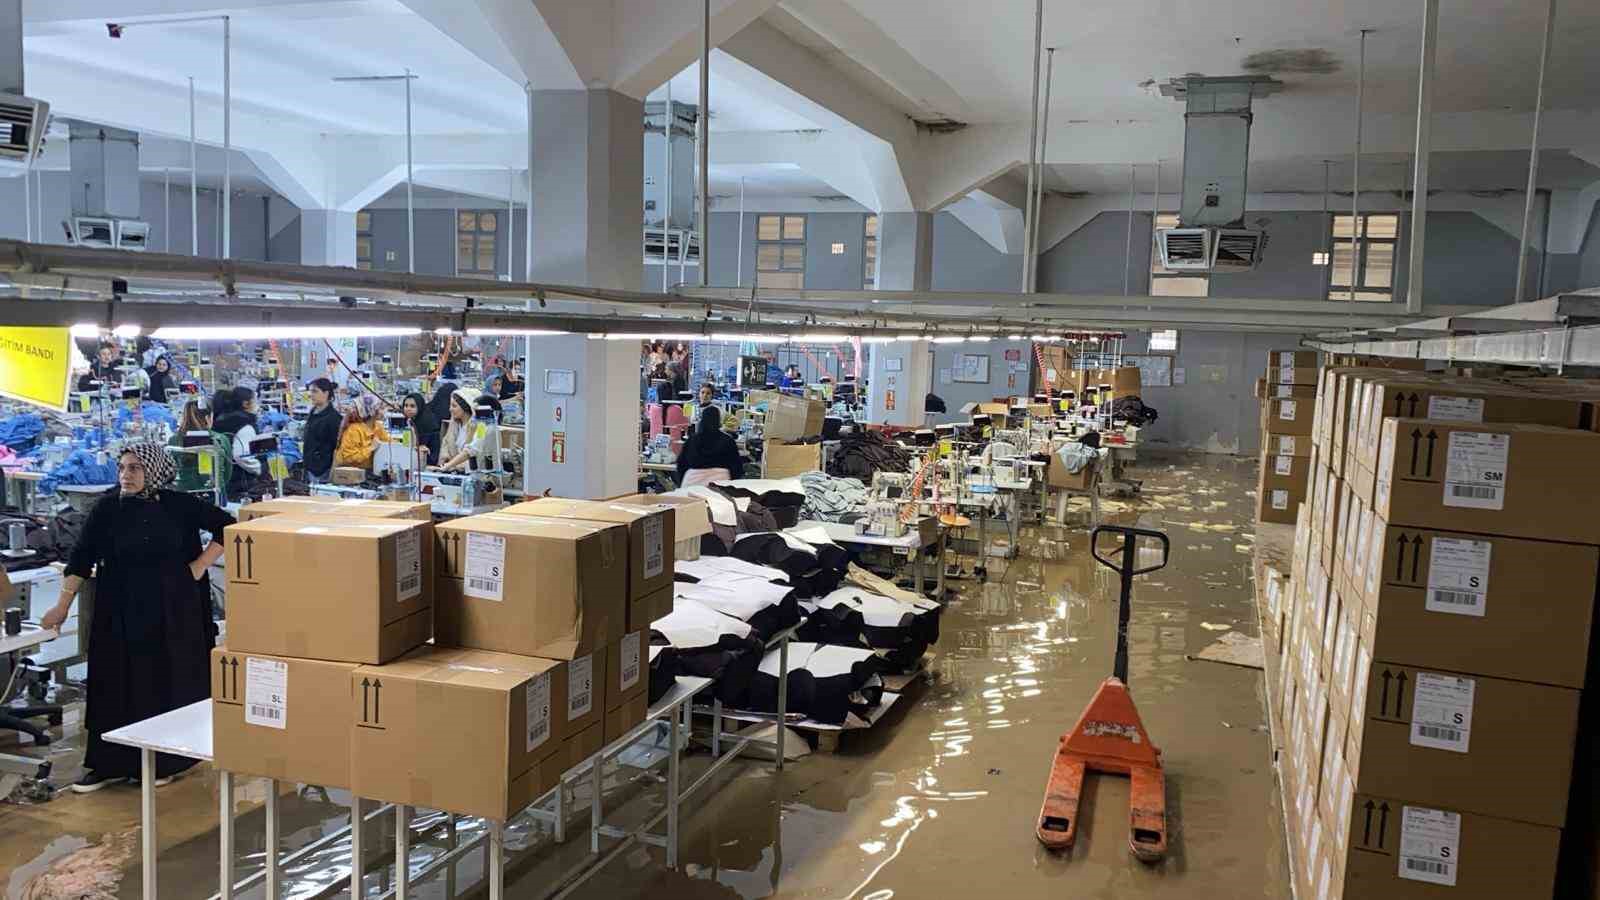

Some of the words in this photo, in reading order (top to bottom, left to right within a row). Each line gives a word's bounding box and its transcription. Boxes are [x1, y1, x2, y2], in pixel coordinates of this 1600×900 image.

[26, 344, 54, 361] BANDI
[556, 406, 562, 422] 9
[1484, 471, 1504, 481] SM
[492, 566, 499, 577] S
[1469, 576, 1480, 588] S
[584, 679, 590, 690] S
[542, 705, 548, 717] S
[1453, 712, 1464, 724] S
[1441, 846, 1451, 858] S
